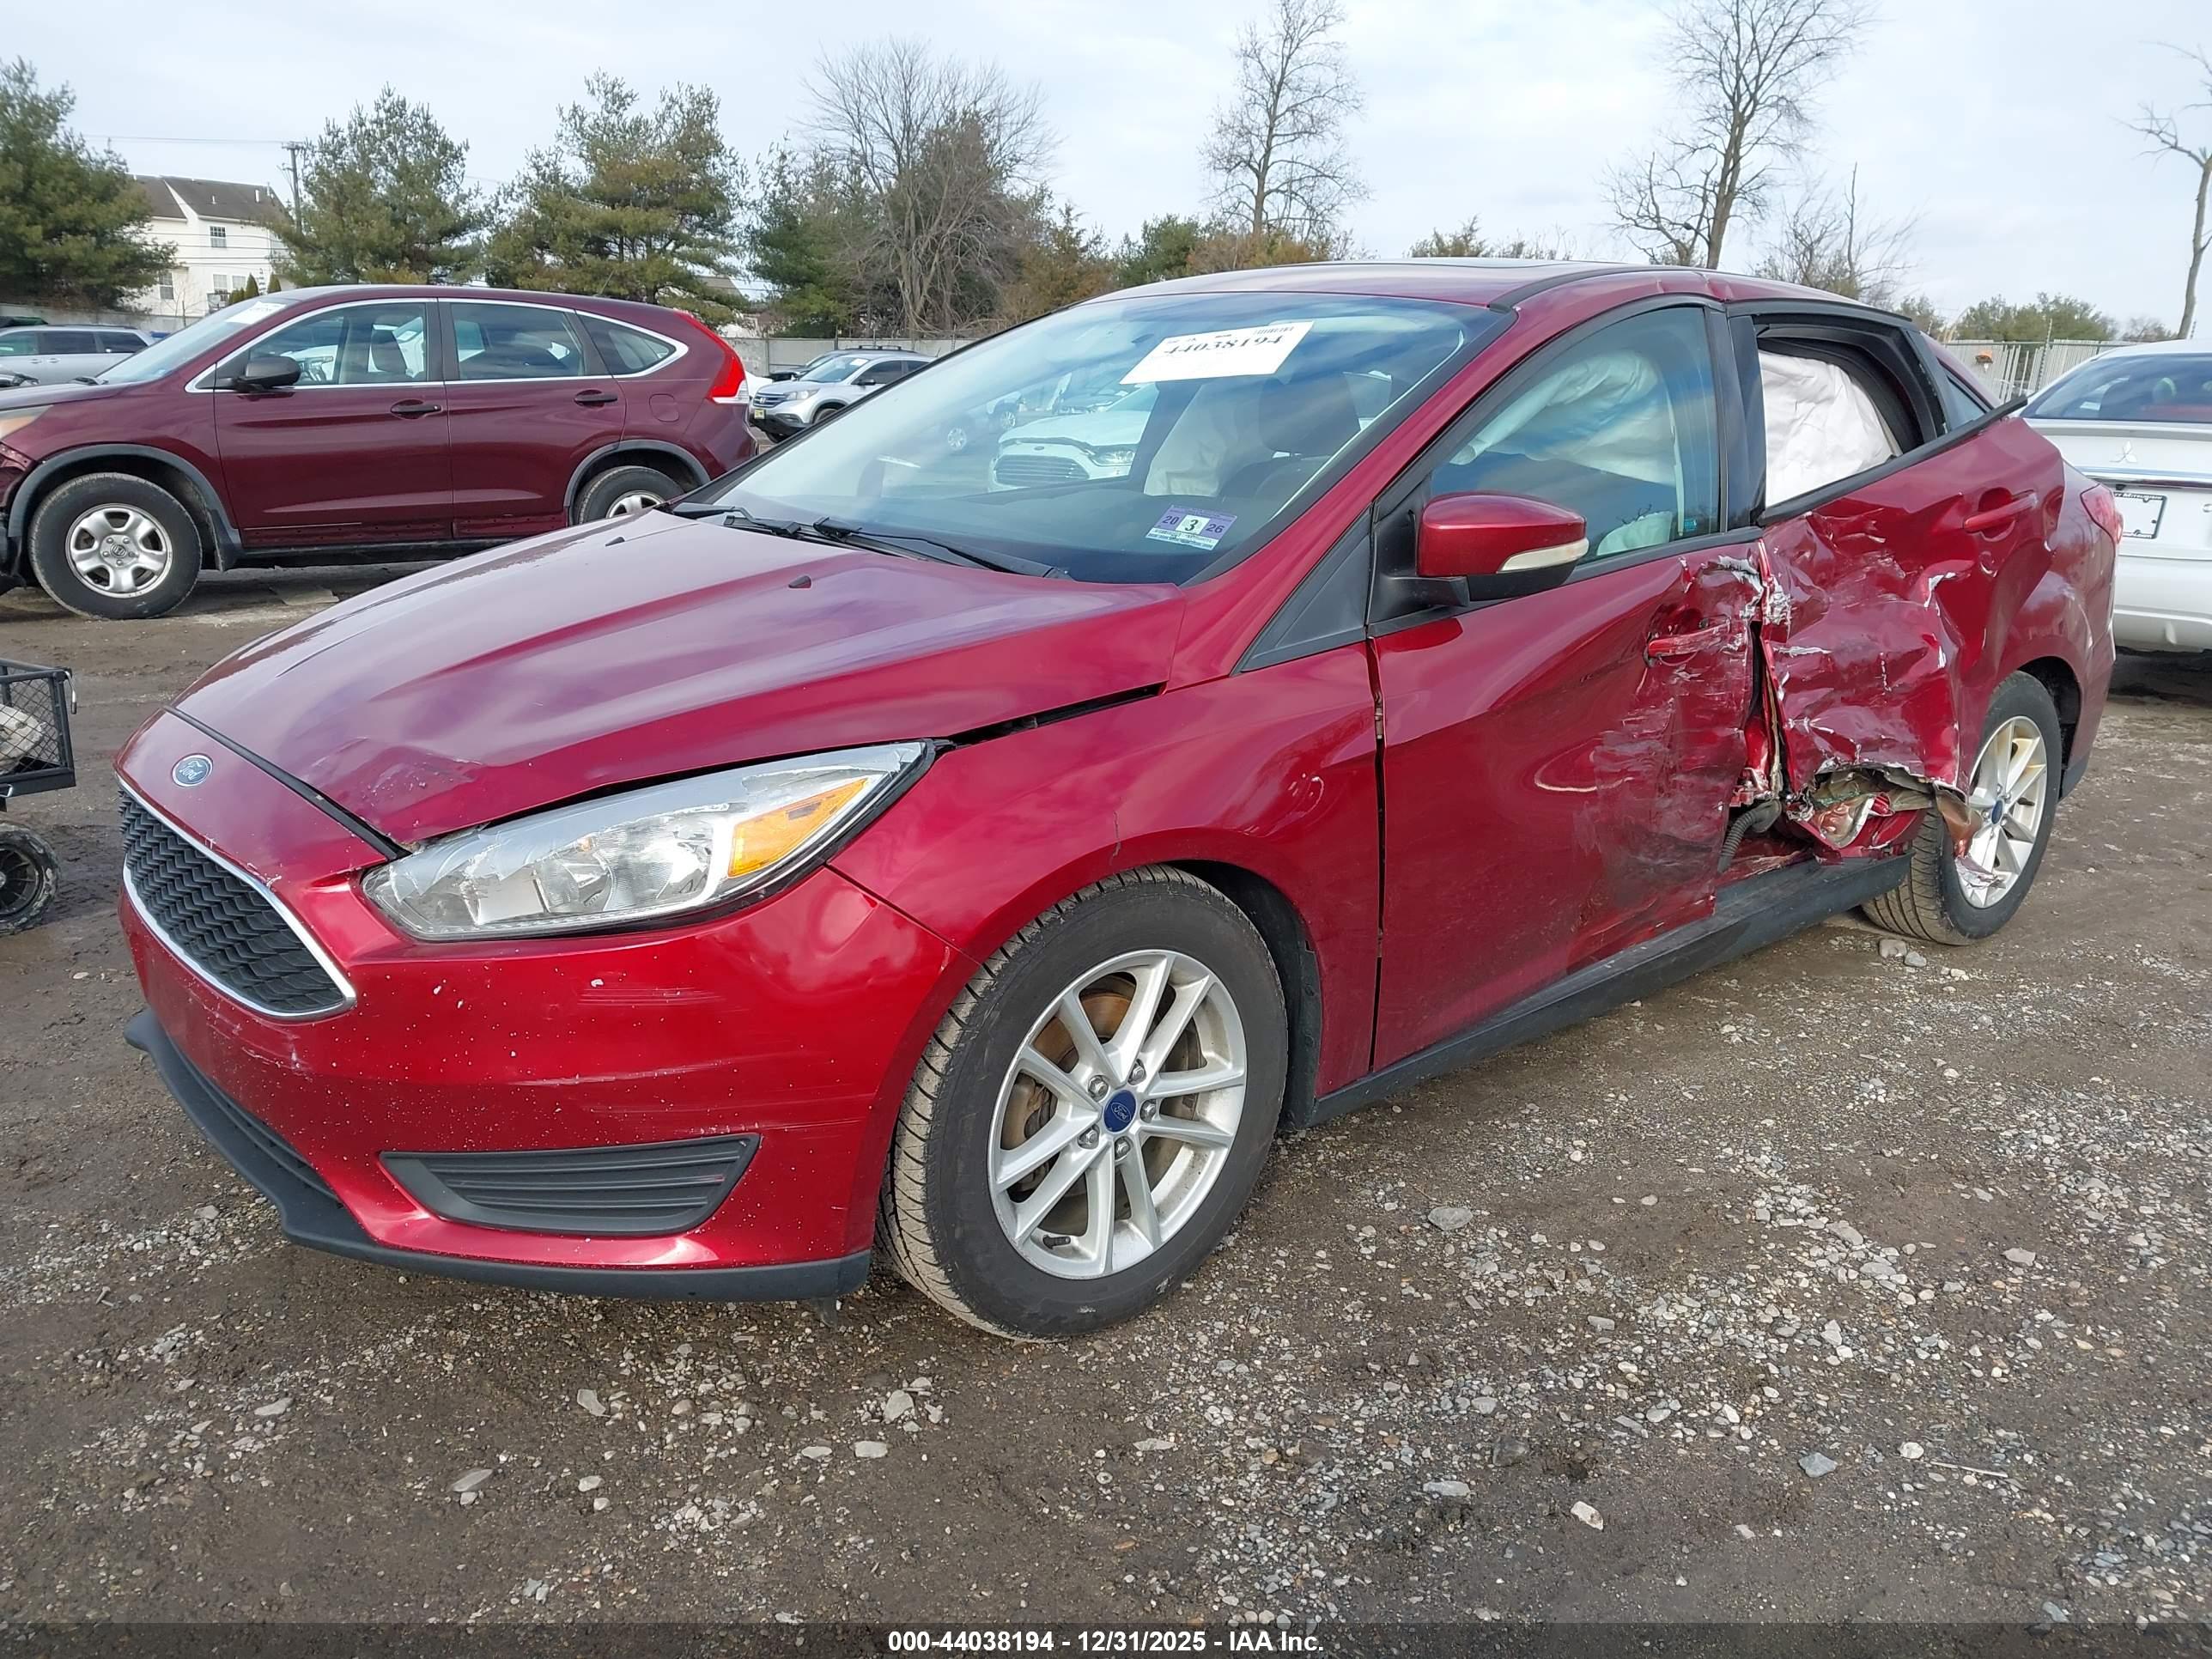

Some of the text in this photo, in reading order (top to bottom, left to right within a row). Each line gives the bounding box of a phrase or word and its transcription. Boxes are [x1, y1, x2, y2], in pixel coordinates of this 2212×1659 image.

[1164, 336, 1282, 354] 44038194
[1163, 515, 1225, 533] 20 3 26
